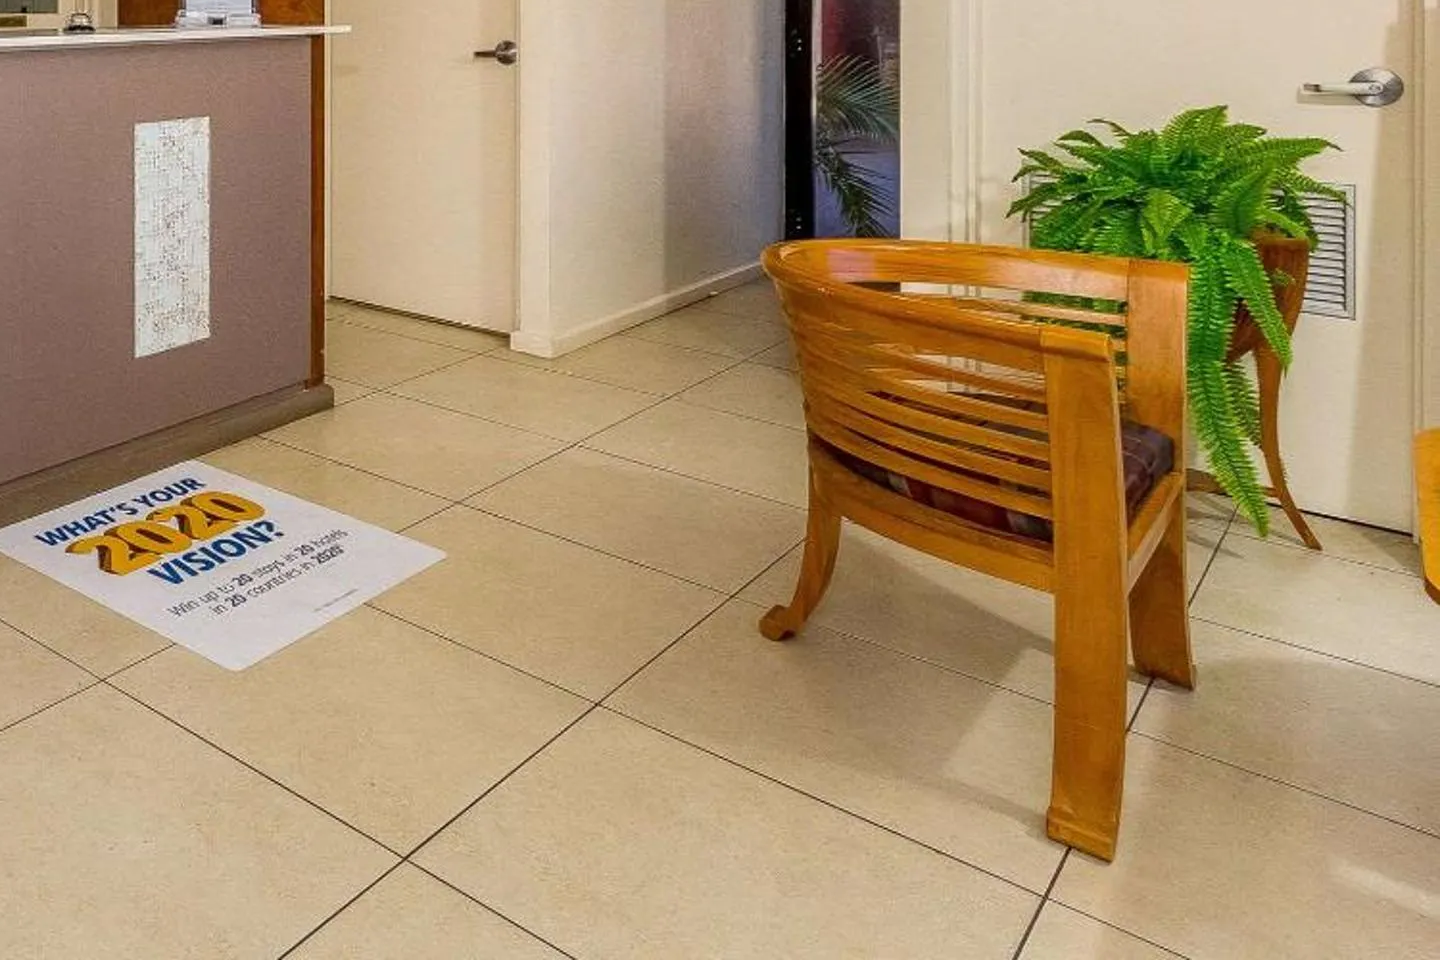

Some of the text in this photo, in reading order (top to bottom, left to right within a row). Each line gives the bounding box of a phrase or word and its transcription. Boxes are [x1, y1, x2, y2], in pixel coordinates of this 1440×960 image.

[34, 477, 208, 546] WHAT'S YOUR
[65, 491, 266, 576] 2020
[147, 519, 284, 585] VISION?
[167, 599, 201, 617] Win
[200, 590, 220, 604] up
[216, 582, 234, 595] to
[232, 573, 254, 587] 20
[294, 544, 315, 556] 20
[212, 604, 228, 615] in
[225, 594, 247, 608] 20
[247, 568, 302, 598] countries
